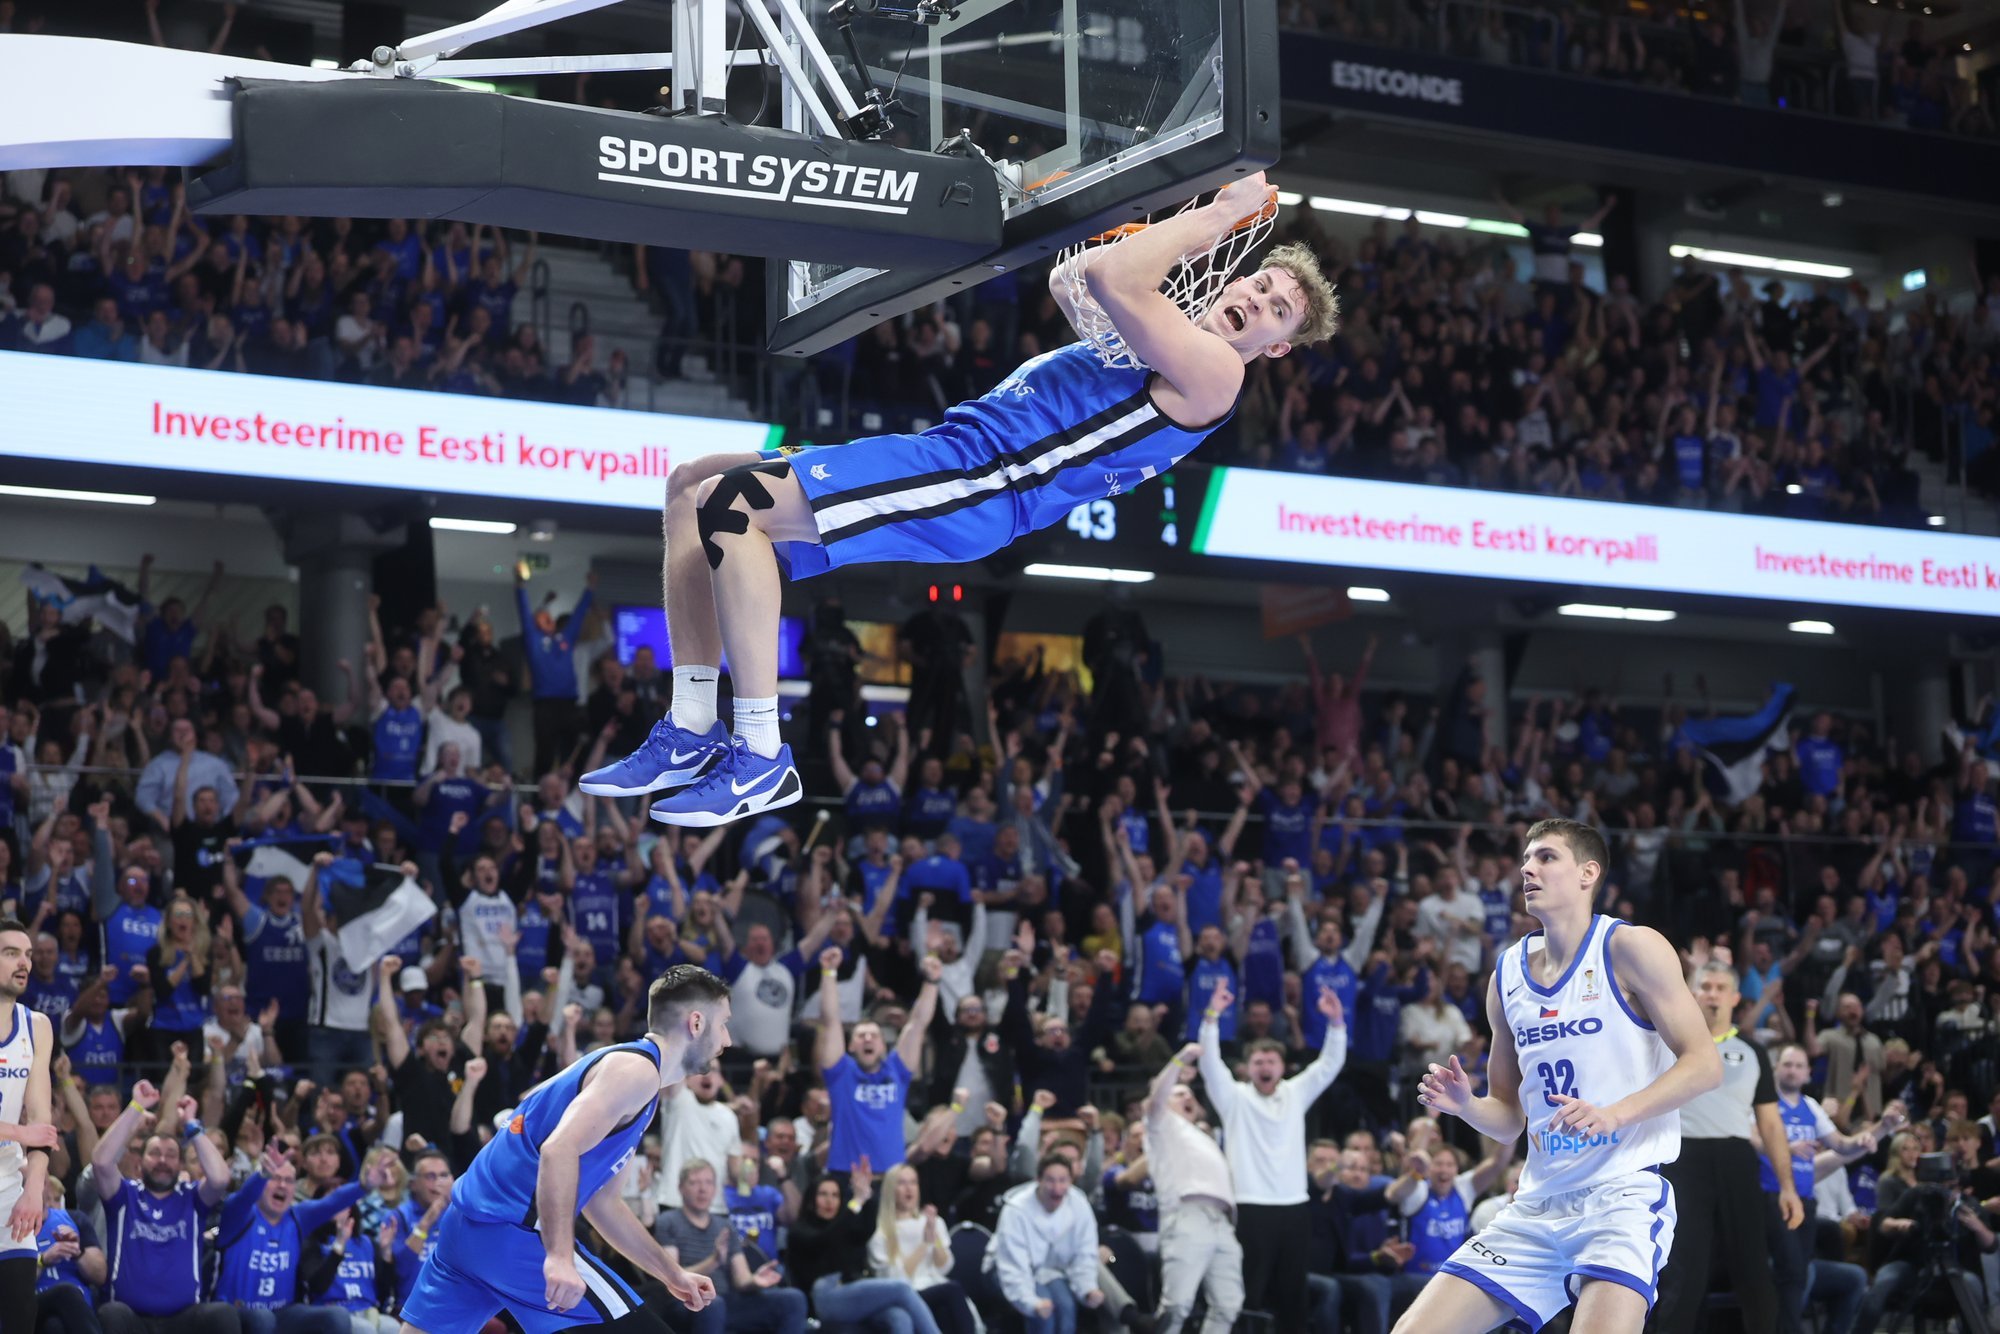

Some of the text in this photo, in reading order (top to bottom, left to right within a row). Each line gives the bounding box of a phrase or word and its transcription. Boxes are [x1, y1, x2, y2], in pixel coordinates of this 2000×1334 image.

[1332, 60, 1462, 105] ESTCONDE
[152, 402, 669, 482] Investeerime Eesti korvpalli
[1067, 499, 1117, 541] 43
[1279, 504, 1659, 566] Investeerime Eesti korvpalli
[1755, 545, 2000, 591] Investeerime Eesti k
[122, 918, 158, 937] EEST
[1517, 1017, 1603, 1048] ČESKO
[1537, 1058, 1579, 1108] 32
[337, 1260, 376, 1278] ESTI
